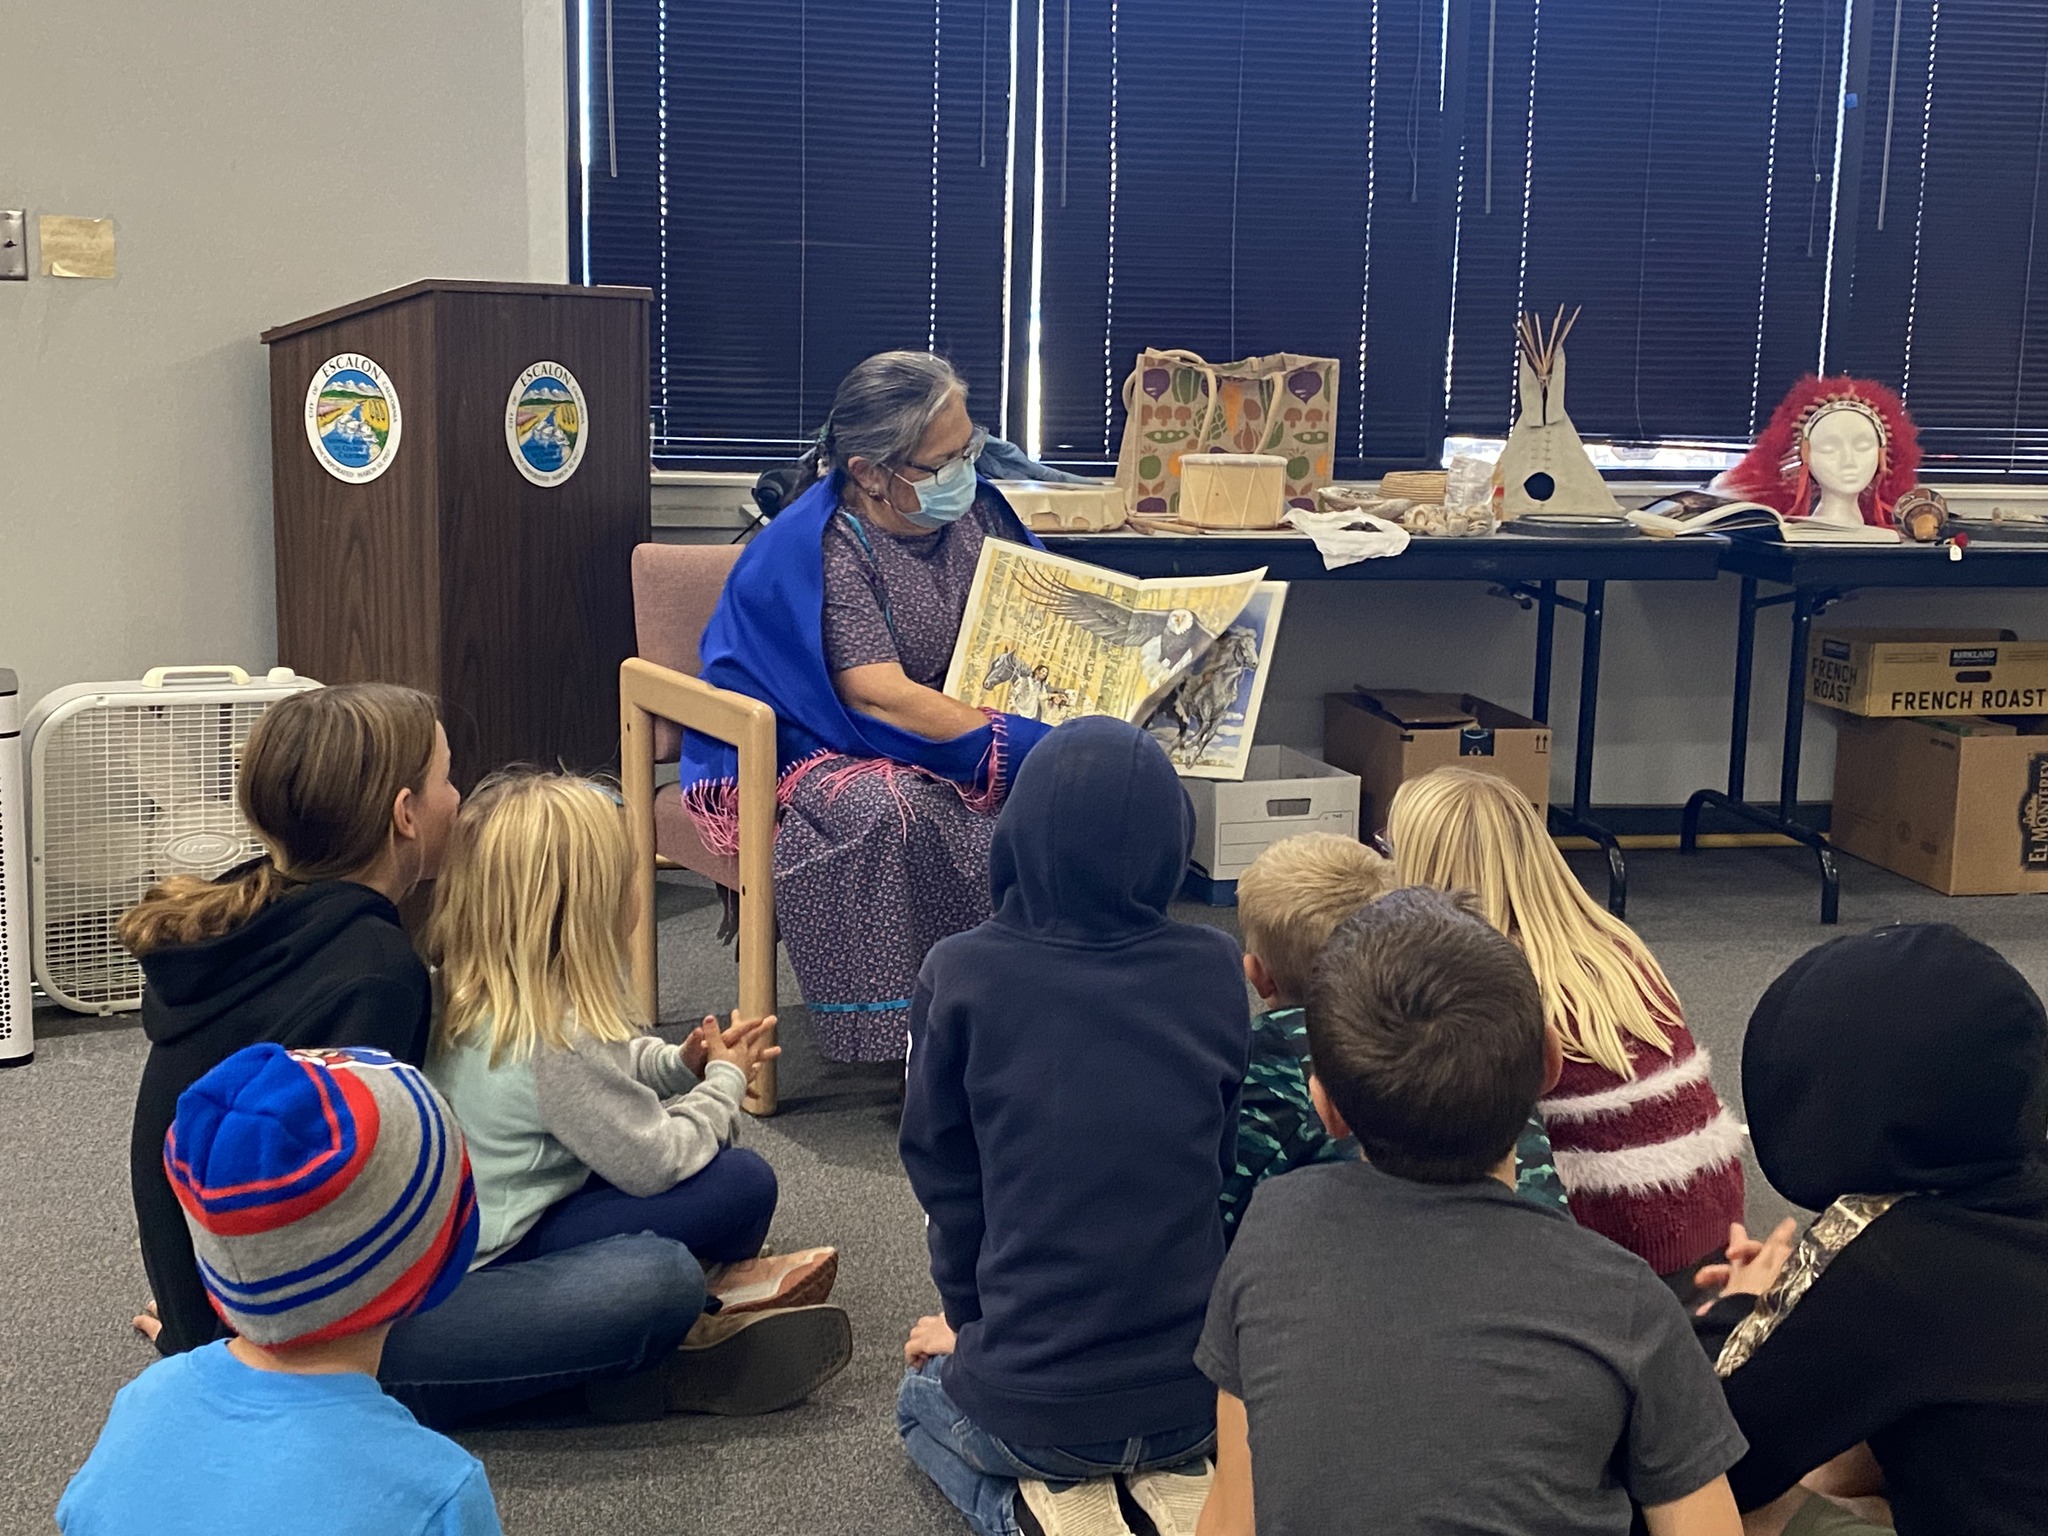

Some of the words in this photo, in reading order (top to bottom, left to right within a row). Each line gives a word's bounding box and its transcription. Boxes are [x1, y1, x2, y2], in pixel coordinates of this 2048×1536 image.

[322, 356, 382, 380] ESCALON
[520, 364, 571, 387] ESCALON
[382, 381, 398, 423] CALIFORNIA
[1953, 650, 1996, 659] KIRKLAND
[1812, 657, 1858, 686] FRENCH
[1813, 678, 1851, 705] ROAST
[1891, 690, 1973, 711] FRENCH
[1982, 688, 2047, 708] ROAST
[2028, 844, 2048, 862] EL
